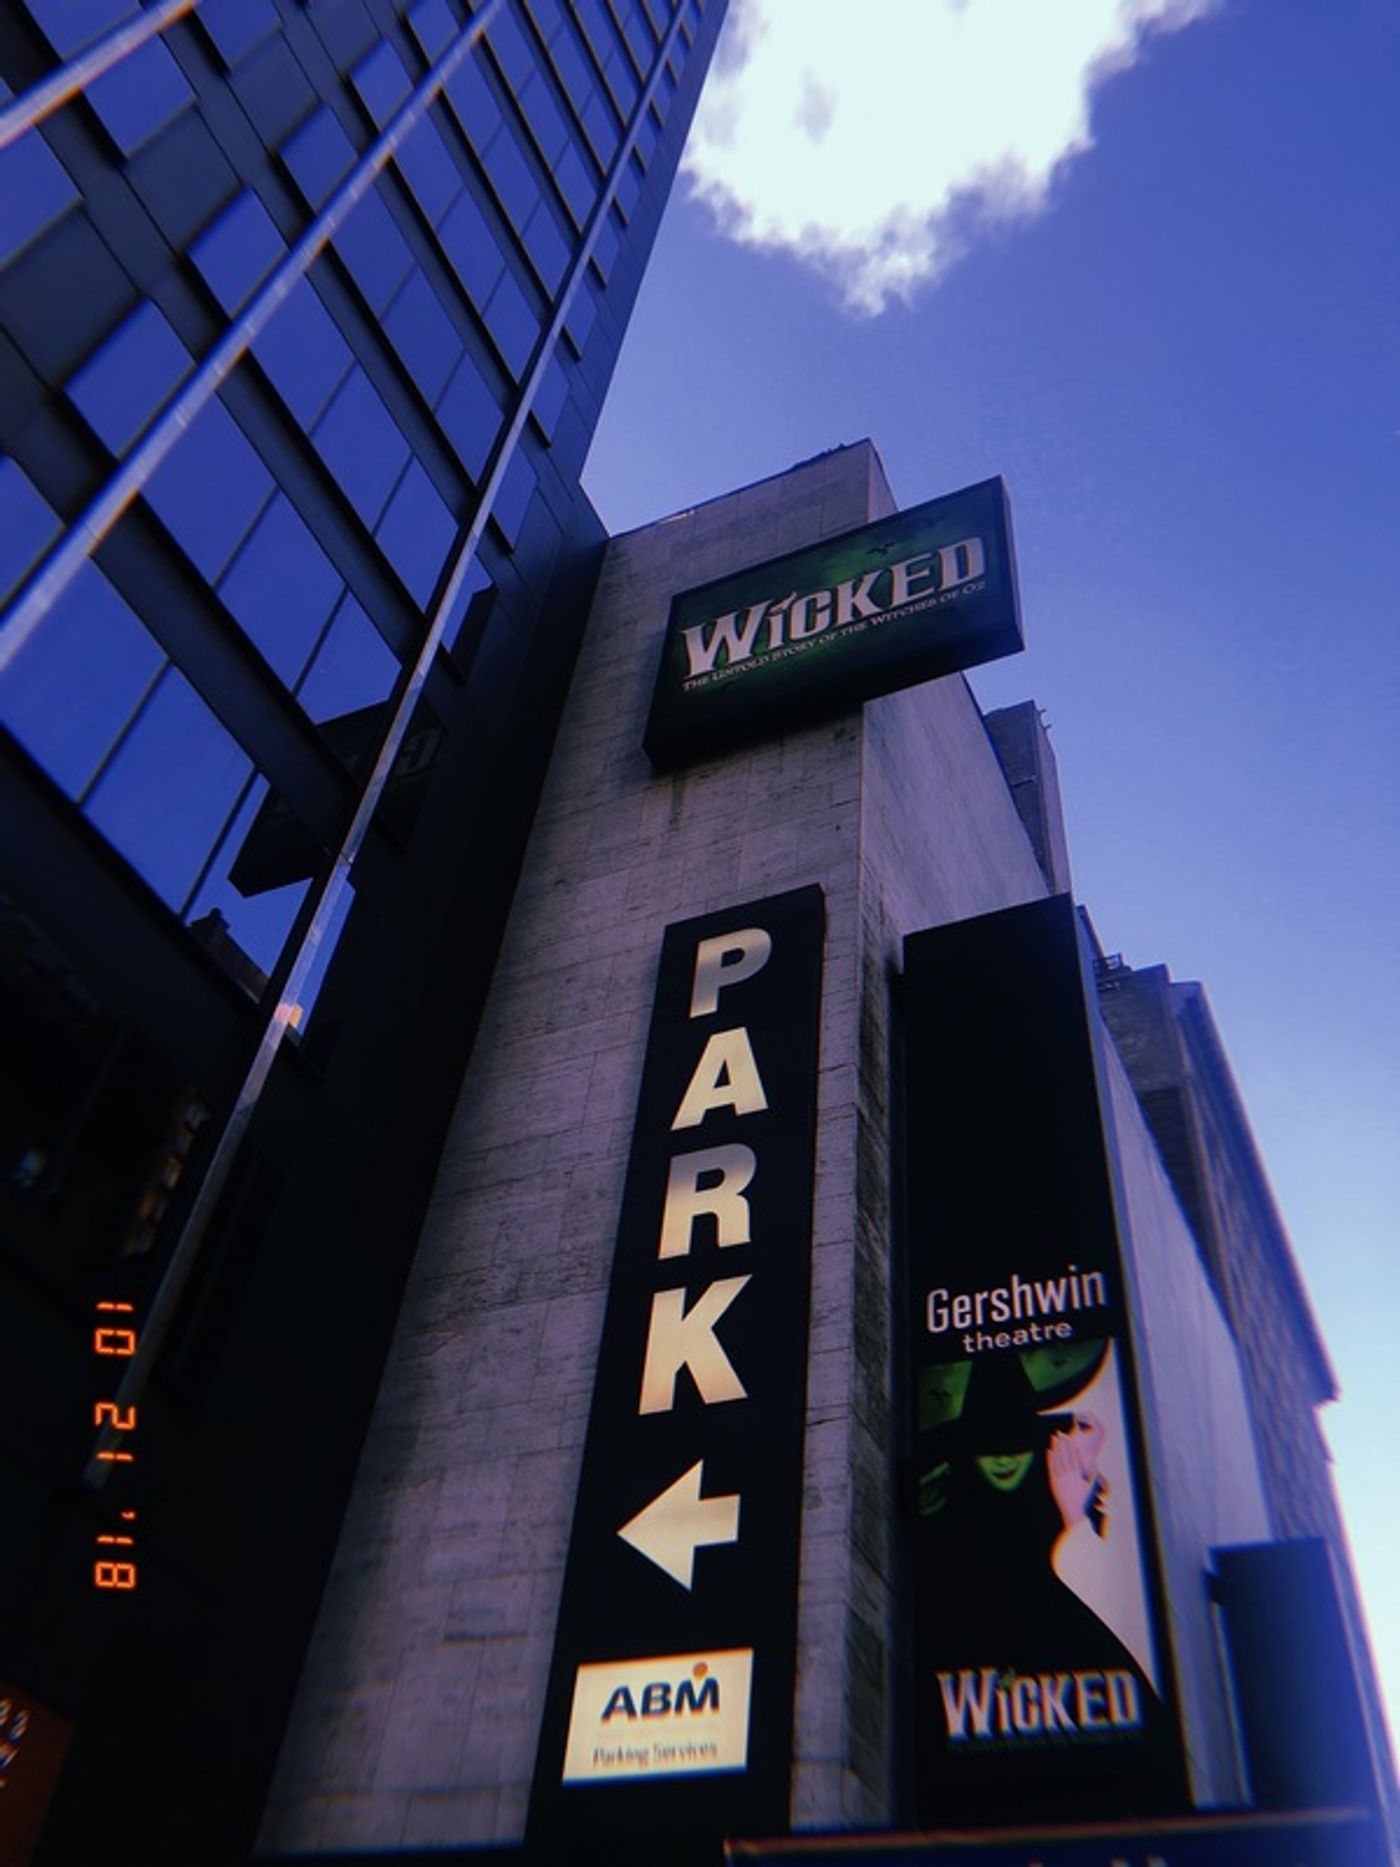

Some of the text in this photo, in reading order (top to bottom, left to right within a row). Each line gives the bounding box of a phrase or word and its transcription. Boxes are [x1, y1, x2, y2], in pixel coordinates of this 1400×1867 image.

[638, 926, 772, 1416] PARK
[926, 1264, 1107, 1334] Gershwin
[962, 1322, 1073, 1353] theatre
[601, 1675, 720, 1722] ABM
